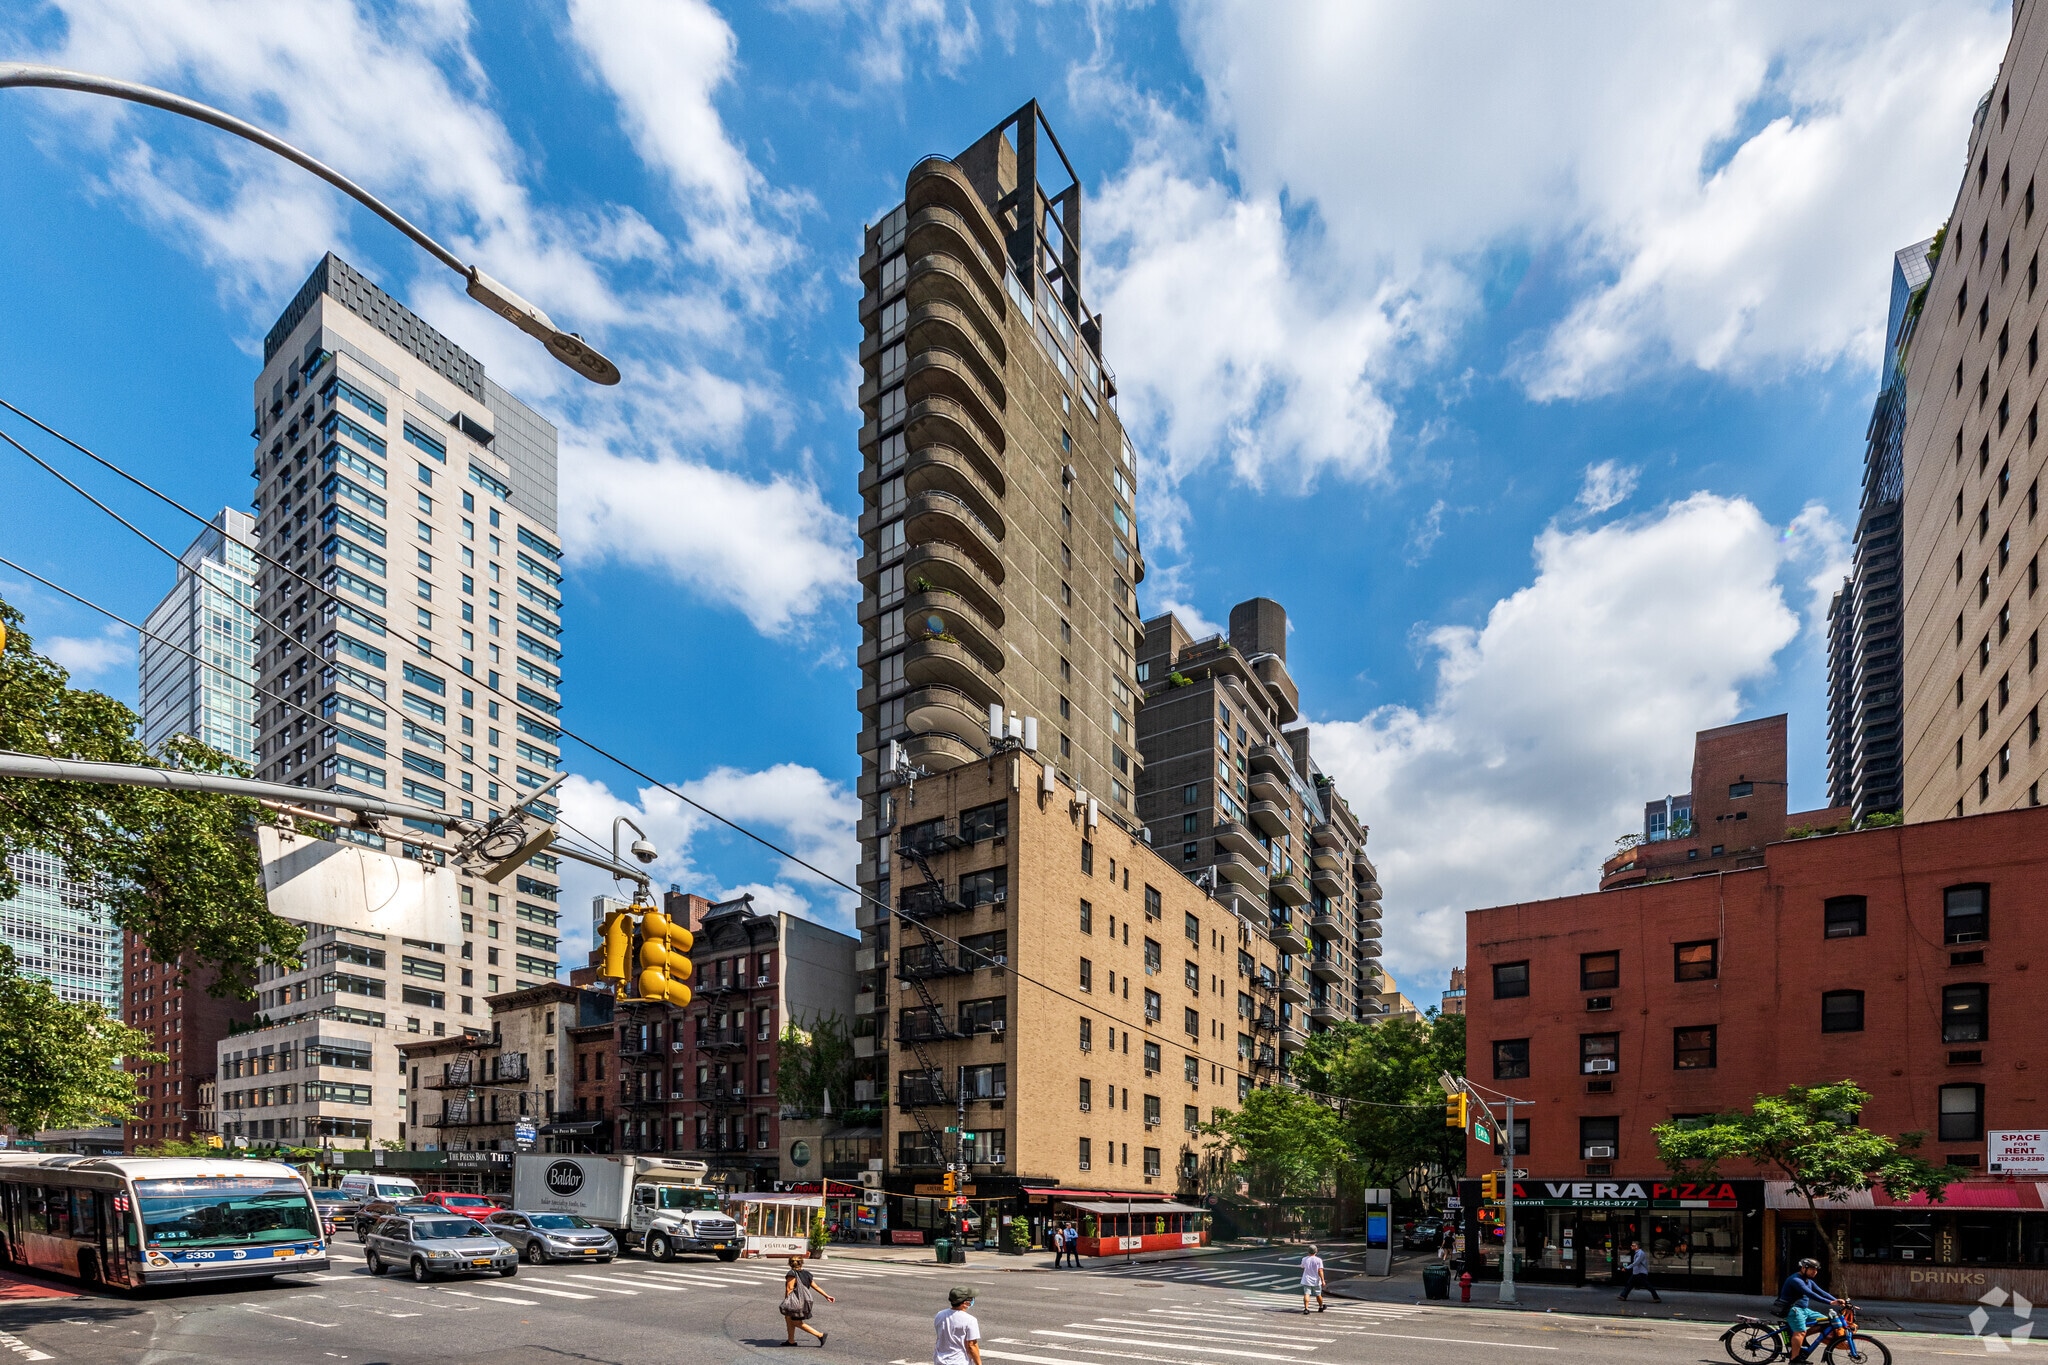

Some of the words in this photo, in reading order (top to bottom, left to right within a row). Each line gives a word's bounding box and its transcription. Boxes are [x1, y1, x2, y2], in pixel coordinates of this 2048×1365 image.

[448, 1152, 460, 1161] THE
[460, 1151, 476, 1161] PRESS
[475, 1151, 487, 1161] BOX
[490, 1152, 511, 1162] THE
[550, 1168, 581, 1187] Baldor
[830, 1183, 853, 1193] Beer
[1545, 1183, 1648, 1199] VERA
[1653, 1183, 1737, 1199] PIZZA
[1489, 1211, 1494, 1219] 4
[1565, 1239, 1571, 1247] A
[1836, 1229, 1845, 1260] Brunch
[1943, 1231, 1952, 1263] Lunch
[185, 1251, 215, 1260] 5330
[1909, 1270, 1986, 1285] DRINKS
